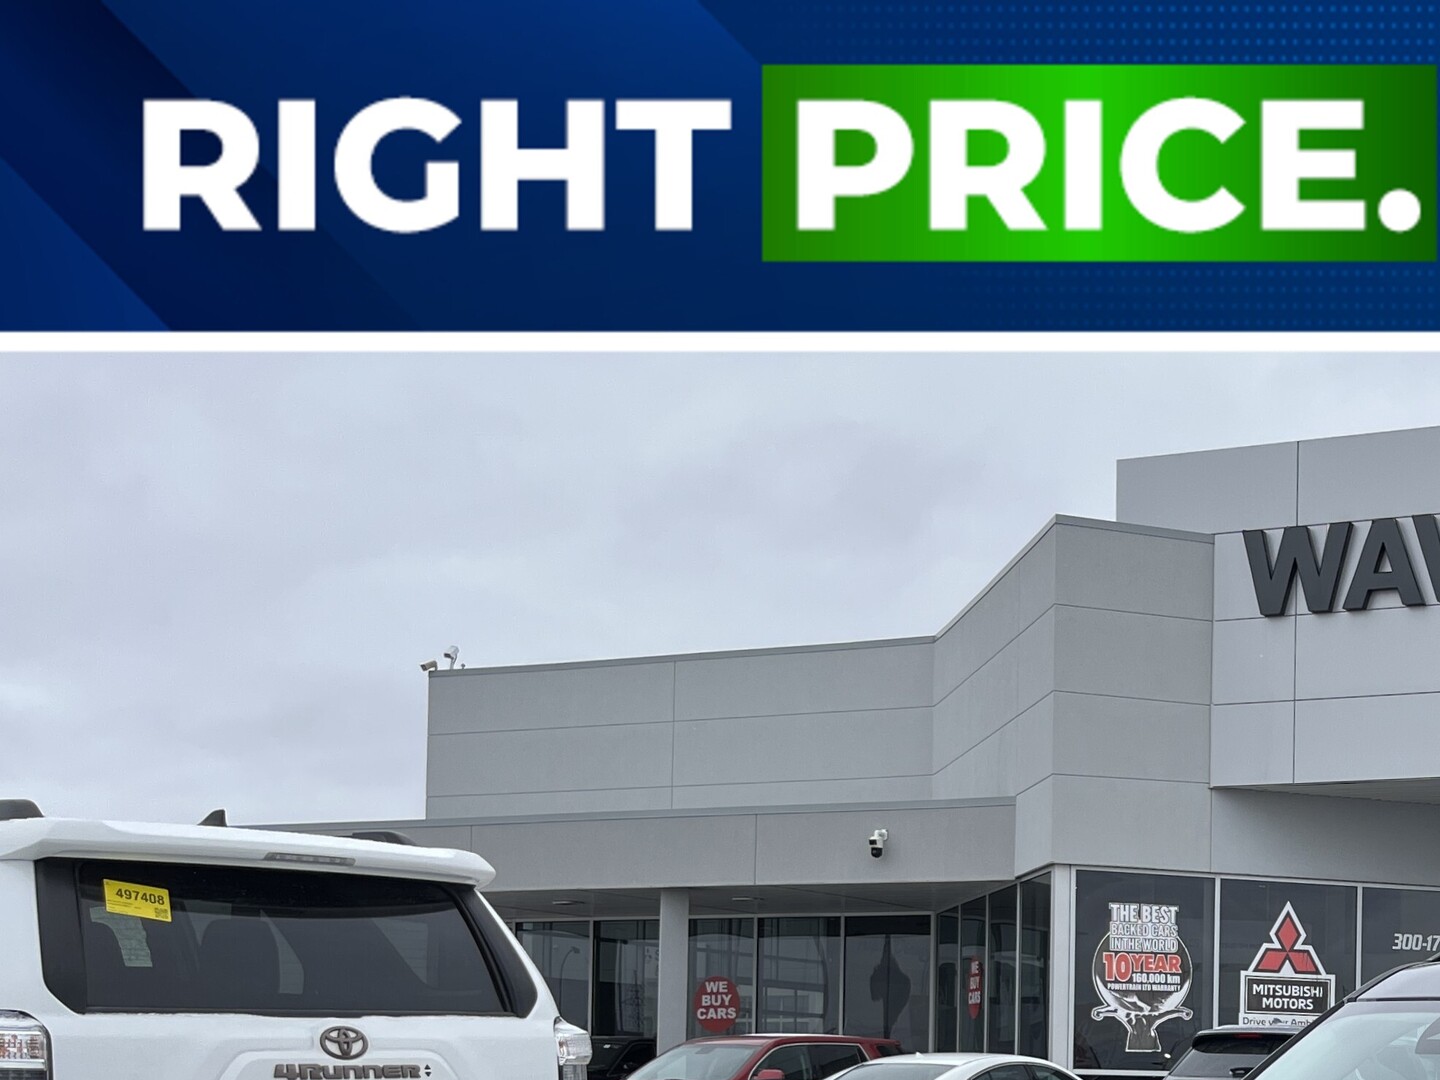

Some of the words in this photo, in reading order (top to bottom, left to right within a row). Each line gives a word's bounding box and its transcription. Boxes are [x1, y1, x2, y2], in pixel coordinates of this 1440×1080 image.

[115, 888, 165, 906] 497408
[1109, 903, 1138, 922] THE
[1141, 904, 1178, 924] BEST
[1111, 922, 1150, 936] BACKED
[1151, 924, 1178, 937] CARS
[1110, 937, 1121, 950] IN
[1121, 937, 1141, 951] THE
[1142, 938, 1178, 952] WORLD
[1103, 952, 1132, 982] 10
[1130, 953, 1181, 974] YEAR
[1167, 974, 1181, 984] km
[705, 981, 728, 993] WE
[1107, 982, 1142, 991] POWERTRAIN
[1152, 984, 1181, 992] WARRANTY
[1252, 984, 1323, 997] MITSUBISHI
[702, 994, 732, 1006] BUY
[1262, 997, 1313, 1010] MOTORS
[696, 1007, 737, 1020] CARS
[1242, 1016, 1266, 1026] Drive
